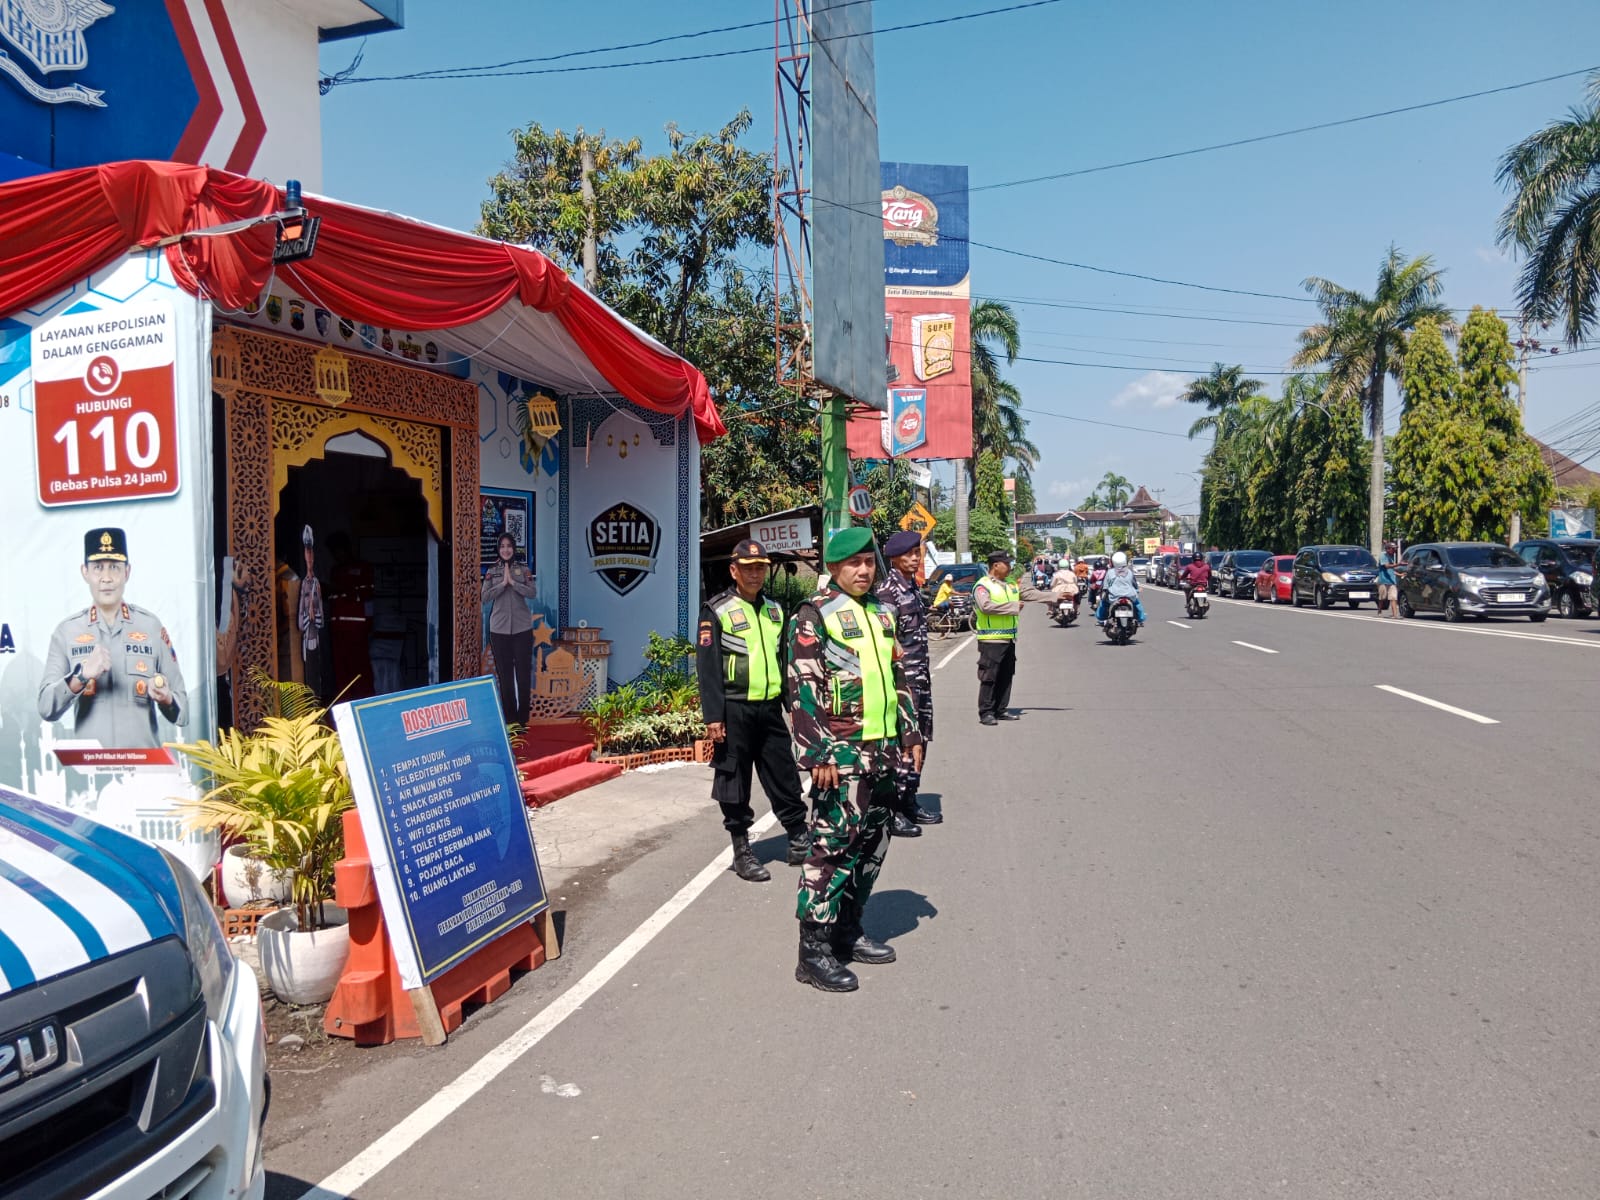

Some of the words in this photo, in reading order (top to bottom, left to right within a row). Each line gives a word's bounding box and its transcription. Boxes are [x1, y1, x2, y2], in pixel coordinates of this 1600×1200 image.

[40, 325, 94, 343] LAYANAN
[97, 313, 166, 334] KEPOLISIAN
[927, 322, 952, 333] SUPER
[42, 344, 83, 360] DALAM
[86, 332, 163, 354] GENGGAMAN
[76, 397, 132, 414] HUBUNGI
[53, 411, 160, 475] 110
[50, 478, 88, 494] (Bebas
[91, 474, 122, 489] Pulsa
[124, 473, 138, 485] 24
[140, 470, 167, 485] Jam)
[596, 522, 650, 544] SETIA
[126, 644, 153, 655] POLRI
[401, 698, 468, 734] HOSPITALITY
[380, 768, 388, 777] 1.
[391, 757, 421, 774] TEMPAT
[422, 749, 447, 765] DUDUK
[383, 782, 391, 792] 2.
[452, 754, 472, 769] TIDUR
[399, 788, 413, 801] AIR
[413, 780, 437, 796] MINUM
[437, 771, 462, 787] GRATIS
[401, 798, 430, 814] SNACK
[428, 787, 453, 805] GRATIS
[405, 806, 443, 828] CHARGING
[444, 797, 471, 813] STATION
[471, 788, 492, 802] UNTUK
[492, 783, 501, 794] HP
[408, 829, 425, 841] WIFI
[425, 816, 451, 834] GRATIS
[412, 836, 438, 855] TOILET
[438, 825, 463, 844] BERSIH
[415, 849, 443, 868] TEMPAT
[444, 834, 474, 856] BERMAIN
[475, 826, 492, 842] ANAK
[410, 891, 421, 903] 10.
[422, 877, 448, 897] RUANG
[449, 862, 477, 883] LAKTASI
[419, 862, 444, 883] POJOK
[444, 854, 464, 870] BACA
